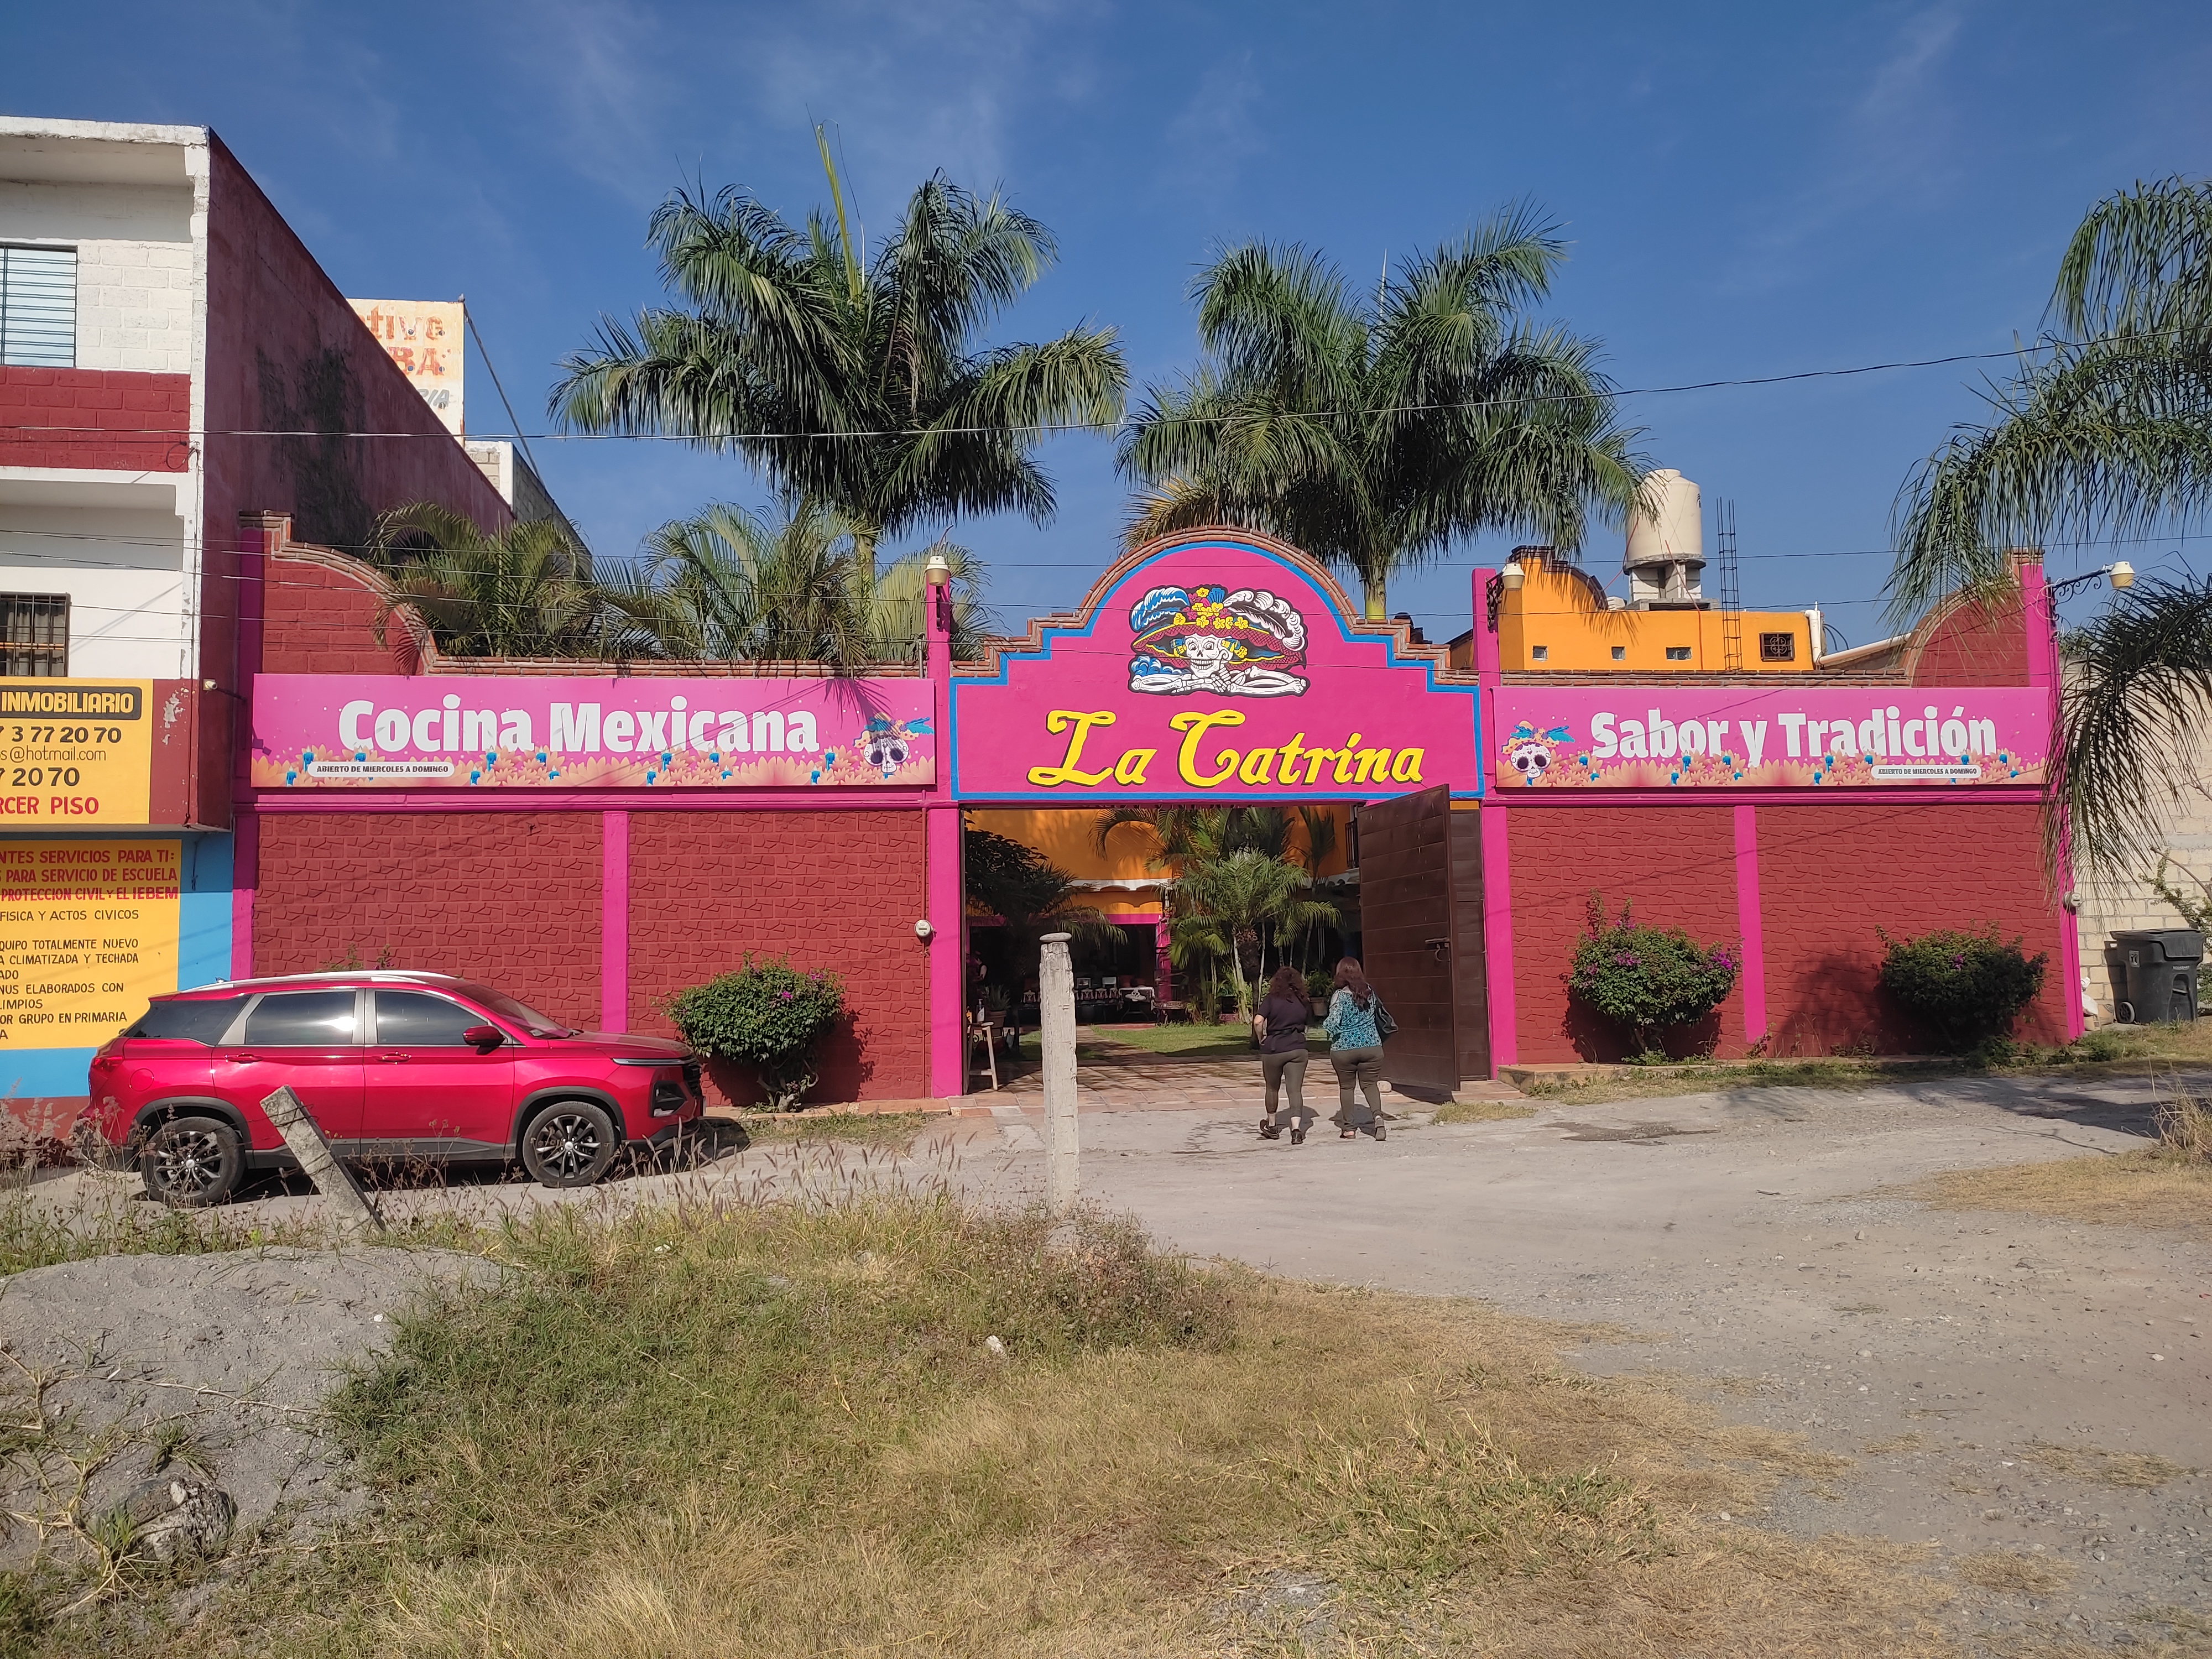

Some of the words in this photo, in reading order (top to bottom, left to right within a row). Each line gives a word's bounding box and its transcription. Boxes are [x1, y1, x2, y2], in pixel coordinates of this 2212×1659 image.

[2, 691, 134, 713] INMOBILIARIO
[338, 693, 535, 753] Cocina
[550, 695, 820, 753] Mexicana
[12, 726, 23, 742] 3
[31, 726, 55, 742] 77
[60, 727, 88, 743] 20
[94, 727, 122, 743] 70
[1590, 708, 1730, 759] Sabor
[1738, 721, 1768, 769] y
[1777, 705, 1997, 758] Tradición
[1026, 709, 1158, 788] La
[1168, 709, 1426, 789] Catrina
[51, 796, 99, 815] PISO
[39, 850, 110, 864] SERVICIOS
[118, 850, 153, 863] PARA
[156, 849, 174, 863] TI:
[6, 869, 36, 883] PARA
[41, 868, 98, 882] SERVICIO
[102, 868, 117, 881] DE
[122, 868, 178, 881] ESCUELA
[1, 887, 71, 901] PROTECCION
[75, 887, 105, 900] CIVIL
[116, 886, 130, 900] EL
[133, 886, 178, 900] IEBEM
[38, 911, 46, 921] Y
[50, 910, 87, 921] ACTOS
[95, 910, 139, 920] CIVICOS
[32, 939, 97, 951] TOTALMENTE
[103, 938, 138, 950] NUEVO
[9, 954, 79, 965] CLIMATIZADA
[84, 954, 91, 963] Y
[96, 953, 139, 964] TECHADA
[26, 983, 95, 994] ELABORADOS
[102, 983, 124, 993] CON
[18, 1013, 54, 1024] GRUPO
[59, 1013, 71, 1024] EN
[75, 1011, 127, 1023] PRIMARIA
